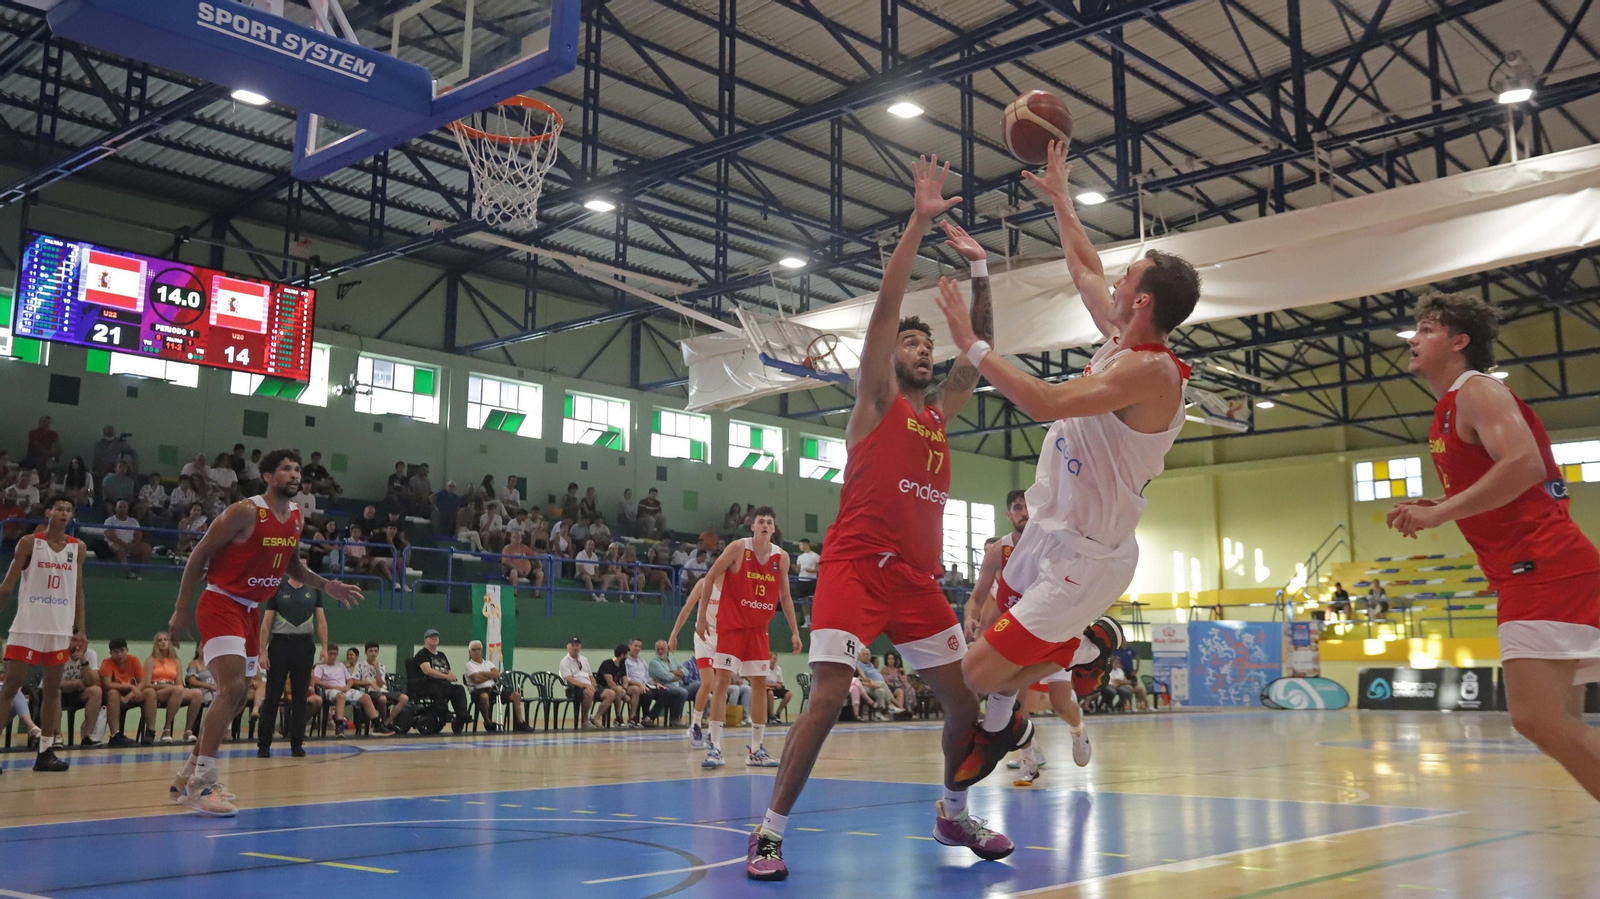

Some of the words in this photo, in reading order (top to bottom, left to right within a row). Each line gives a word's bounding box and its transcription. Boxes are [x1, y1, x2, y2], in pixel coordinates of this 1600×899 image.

[157, 286, 200, 308] 14.0
[103, 310, 117, 318] U22
[92, 324, 121, 345] 21
[156, 324, 187, 336] PERIODO
[224, 346, 250, 365] 14
[907, 417, 945, 443] ESPAÑ
[927, 449, 944, 474] 17
[899, 479, 949, 505] endes
[263, 536, 296, 546] ESPAÑ
[37, 562, 72, 571] ESPAÑA
[272, 553, 282, 568] 11
[47, 575, 60, 589] 10
[248, 575, 281, 587] endes
[746, 571, 775, 582] ESPAÑA
[755, 585, 766, 597] 13
[741, 599, 773, 611] endesa
